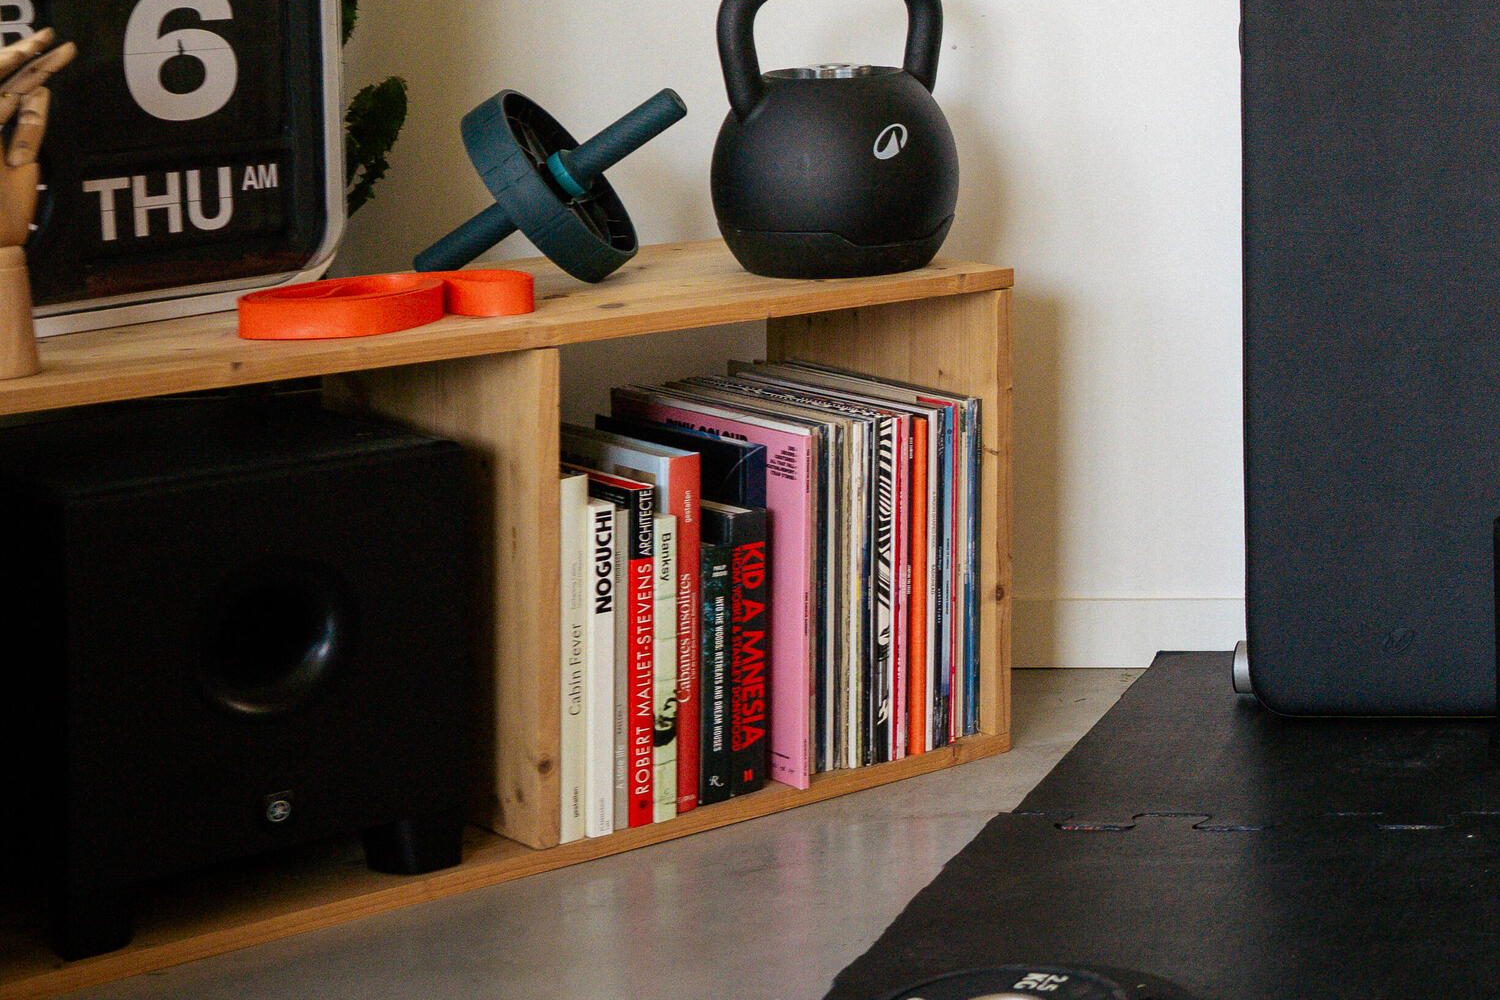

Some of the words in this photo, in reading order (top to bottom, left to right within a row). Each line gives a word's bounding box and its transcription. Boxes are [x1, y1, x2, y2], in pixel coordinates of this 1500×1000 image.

[82, 166, 235, 241] THU
[242, 163, 278, 192] AM
[639, 489, 654, 556] ARCHITECTE
[595, 510, 612, 615] NOGUCHI
[660, 532, 672, 582] Banksy
[731, 547, 742, 585] THOM
[742, 541, 765, 589] KID
[677, 573, 691, 635] insolites
[715, 596, 725, 612] INTO
[715, 612, 724, 625] THE
[731, 585, 742, 623] YORKE
[742, 599, 765, 623] A
[568, 623, 583, 667] Fever
[714, 651, 724, 685] RETREATS
[731, 636, 742, 683] STANLEY
[678, 637, 691, 703] Cabanes
[714, 685, 723, 700] AND
[741, 631, 765, 749] MNESIA
[568, 671, 582, 716] Cabin
[713, 700, 723, 725] DREAM
[713, 725, 723, 752] HOUSES
[731, 685, 742, 752] DONWOOD
[635, 726, 651, 795] ROBERT
